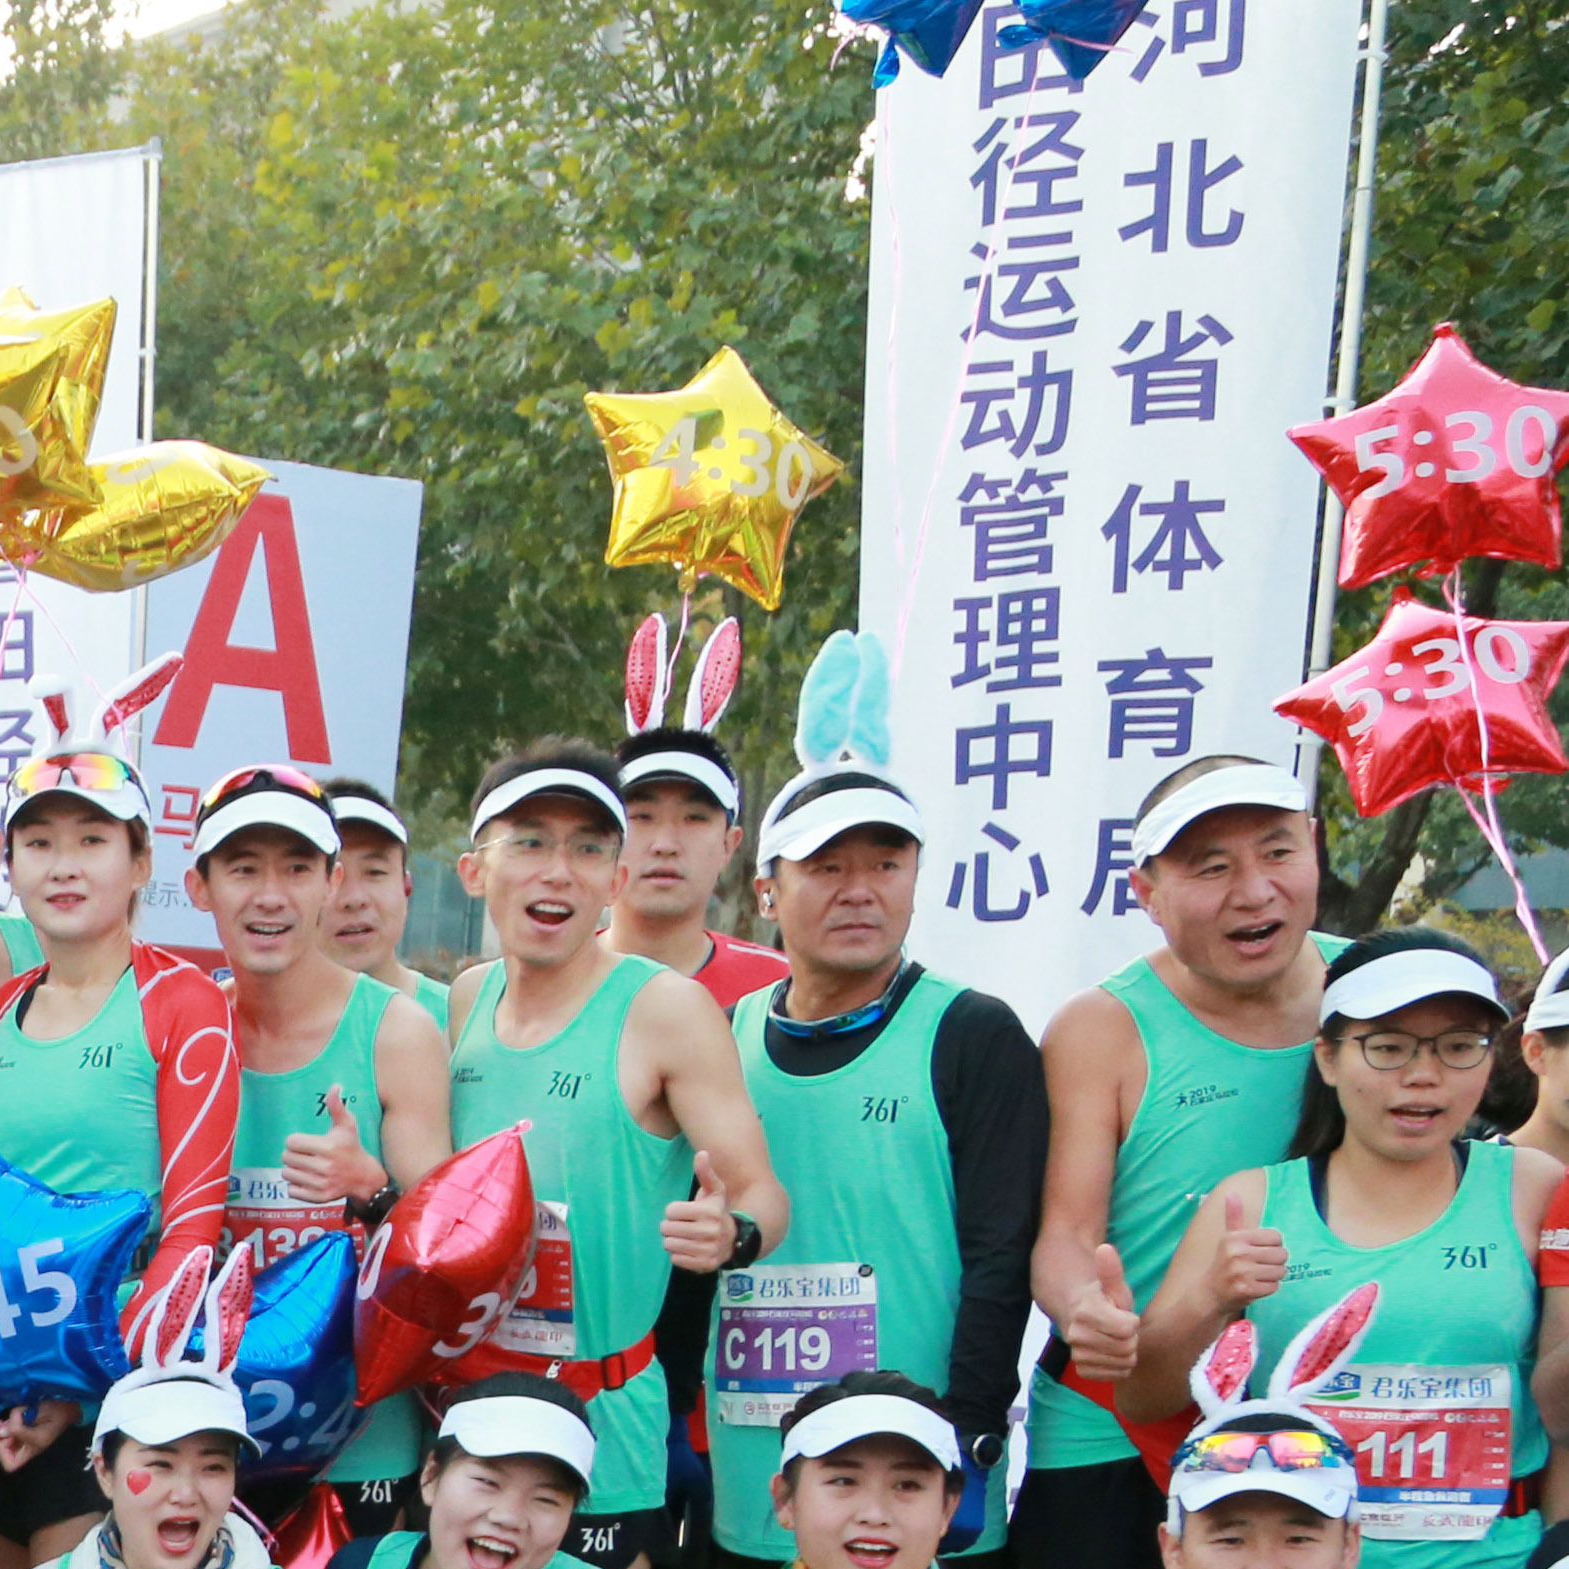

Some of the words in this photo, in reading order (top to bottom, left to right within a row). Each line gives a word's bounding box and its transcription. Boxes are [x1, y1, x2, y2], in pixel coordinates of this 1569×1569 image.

[650, 413, 814, 510] 4:30
[1354, 403, 1561, 500] 5:30
[152, 492, 332, 765] A
[1329, 626, 1530, 740] 5:30
[79, 1041, 124, 1069] 361°
[547, 1070, 593, 1100] 361°
[1189, 1085, 1217, 1097] 2019
[861, 1095, 909, 1124] 361°
[1441, 1243, 1497, 1271] 361°
[758, 1276, 860, 1299] 君乐宝集团
[724, 1327, 746, 1372] C
[754, 1326, 832, 1372] 119
[1371, 1376, 1493, 1398] 君乐宝集团
[1357, 1431, 1449, 1478] 111
[580, 1522, 621, 1553] 361°
